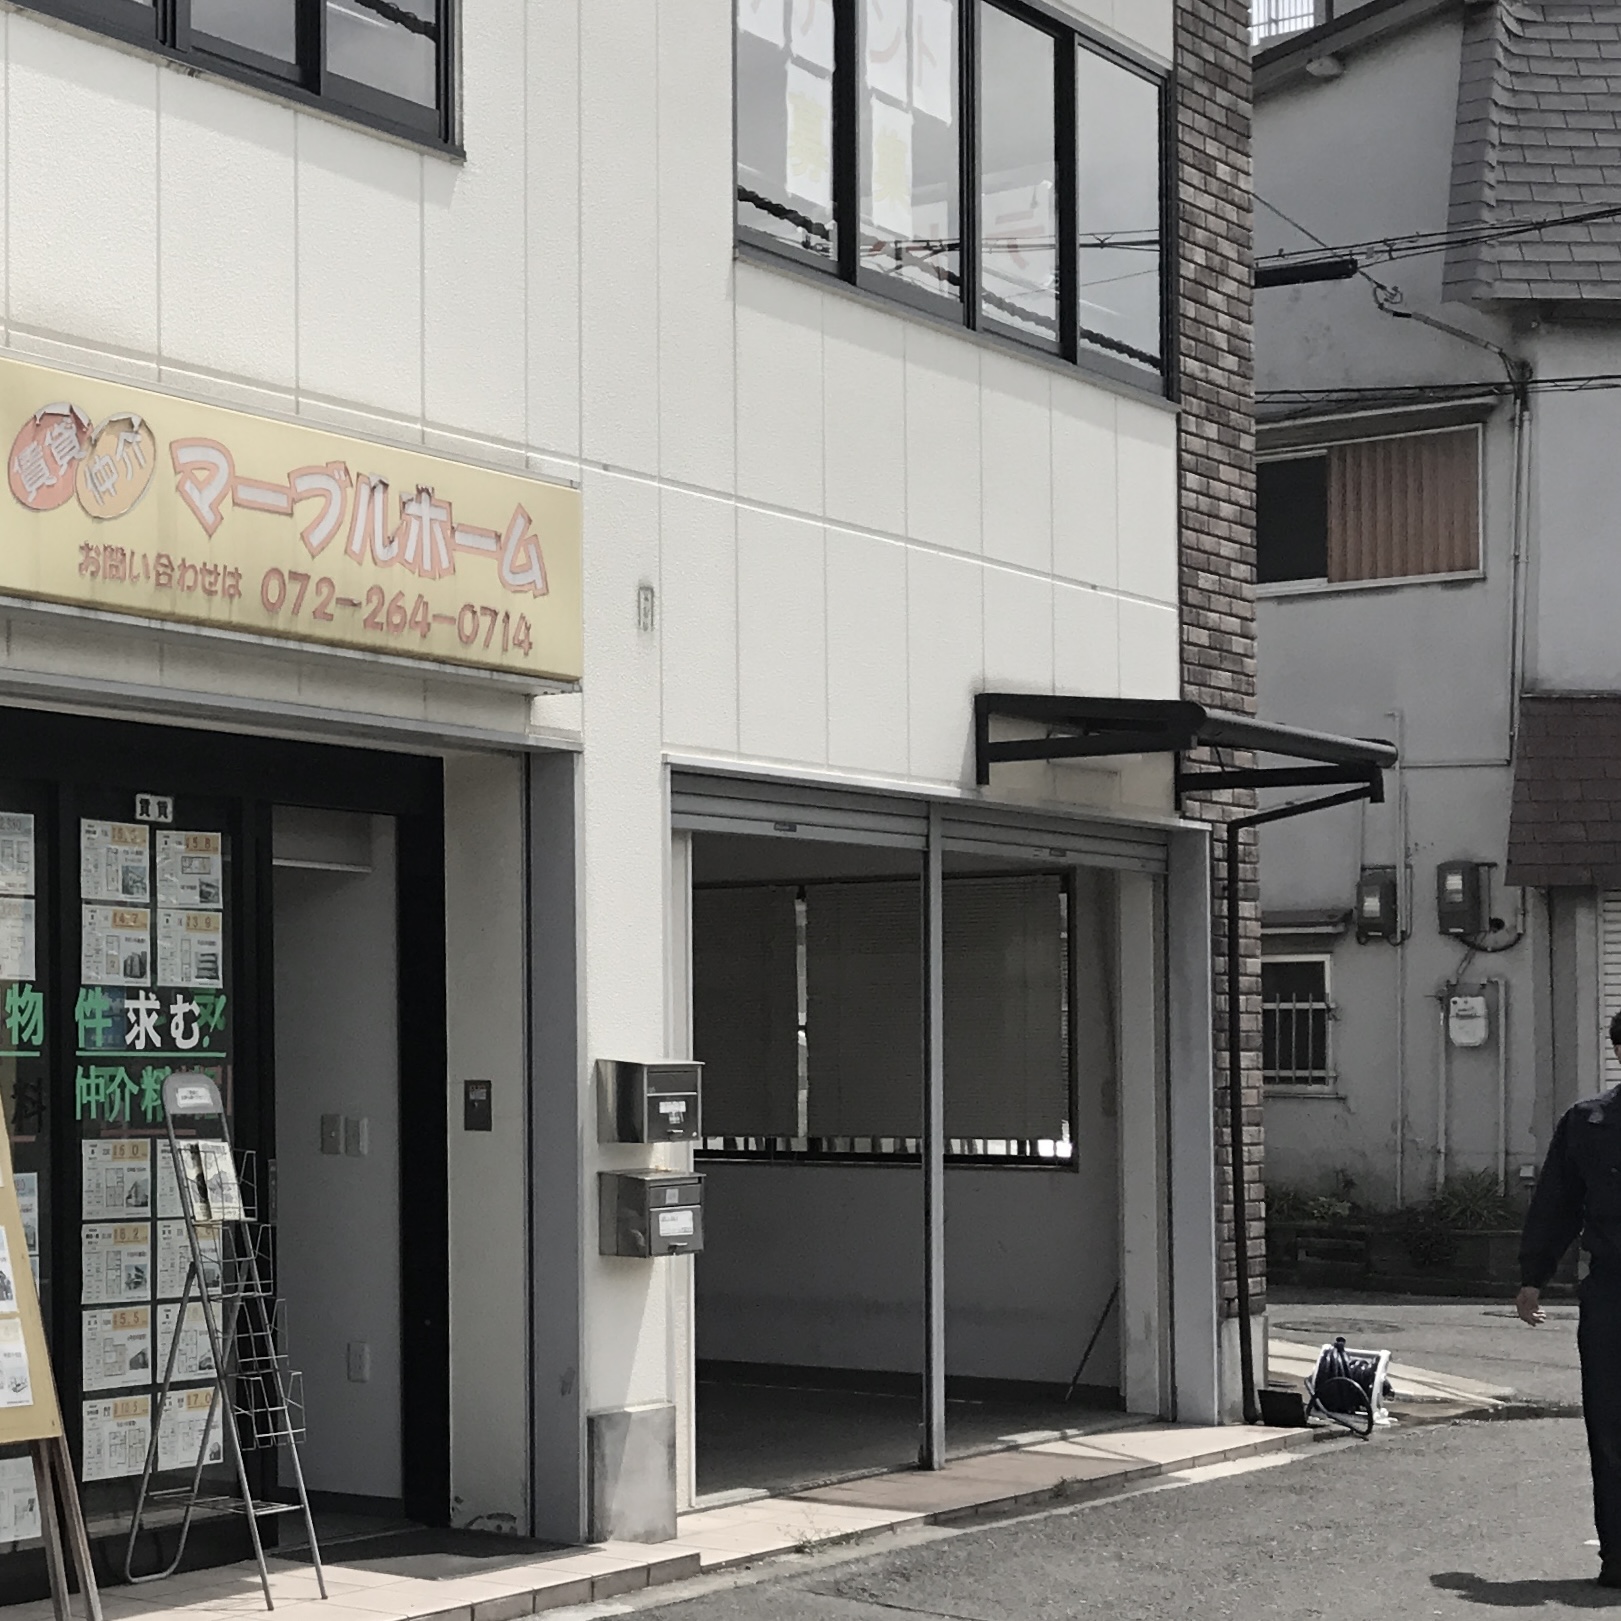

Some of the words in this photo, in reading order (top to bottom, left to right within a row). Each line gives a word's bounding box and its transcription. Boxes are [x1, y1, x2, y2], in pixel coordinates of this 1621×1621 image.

[14, 417, 87, 502] 賃貸
[84, 431, 147, 505] 仲介
[170, 437, 549, 598] マーブルホーム
[78, 542, 243, 598] お問い合わせは
[261, 568, 533, 656] 072-264-0714
